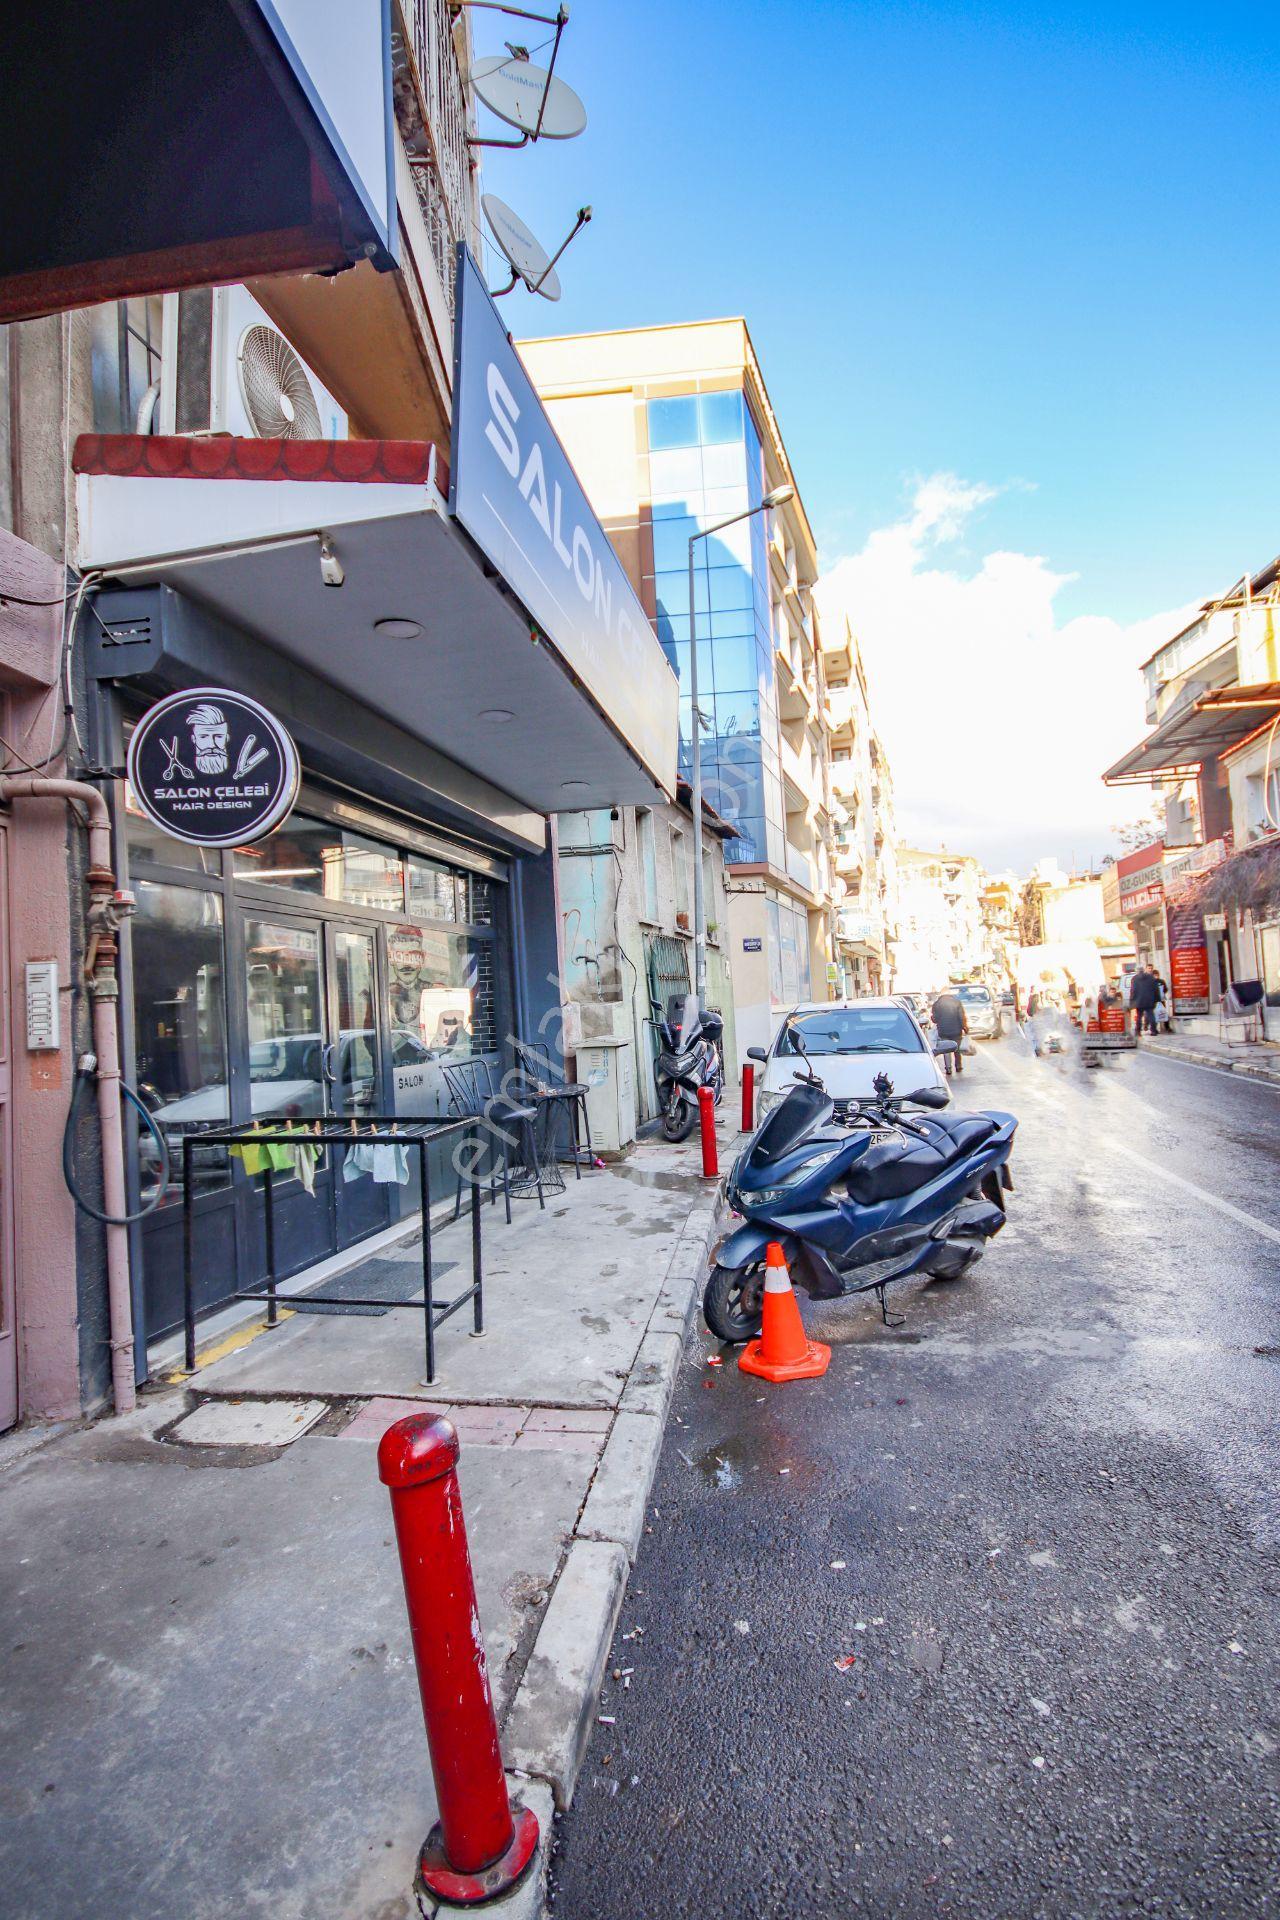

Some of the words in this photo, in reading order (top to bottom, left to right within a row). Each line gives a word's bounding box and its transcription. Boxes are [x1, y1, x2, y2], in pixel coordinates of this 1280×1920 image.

[485, 362, 611, 636] SALON
[154, 787, 211, 799] SALON
[214, 782, 269, 801] ÇELEBİ
[172, 802, 204, 811] HAIR
[206, 801, 252, 810] DESIGN
